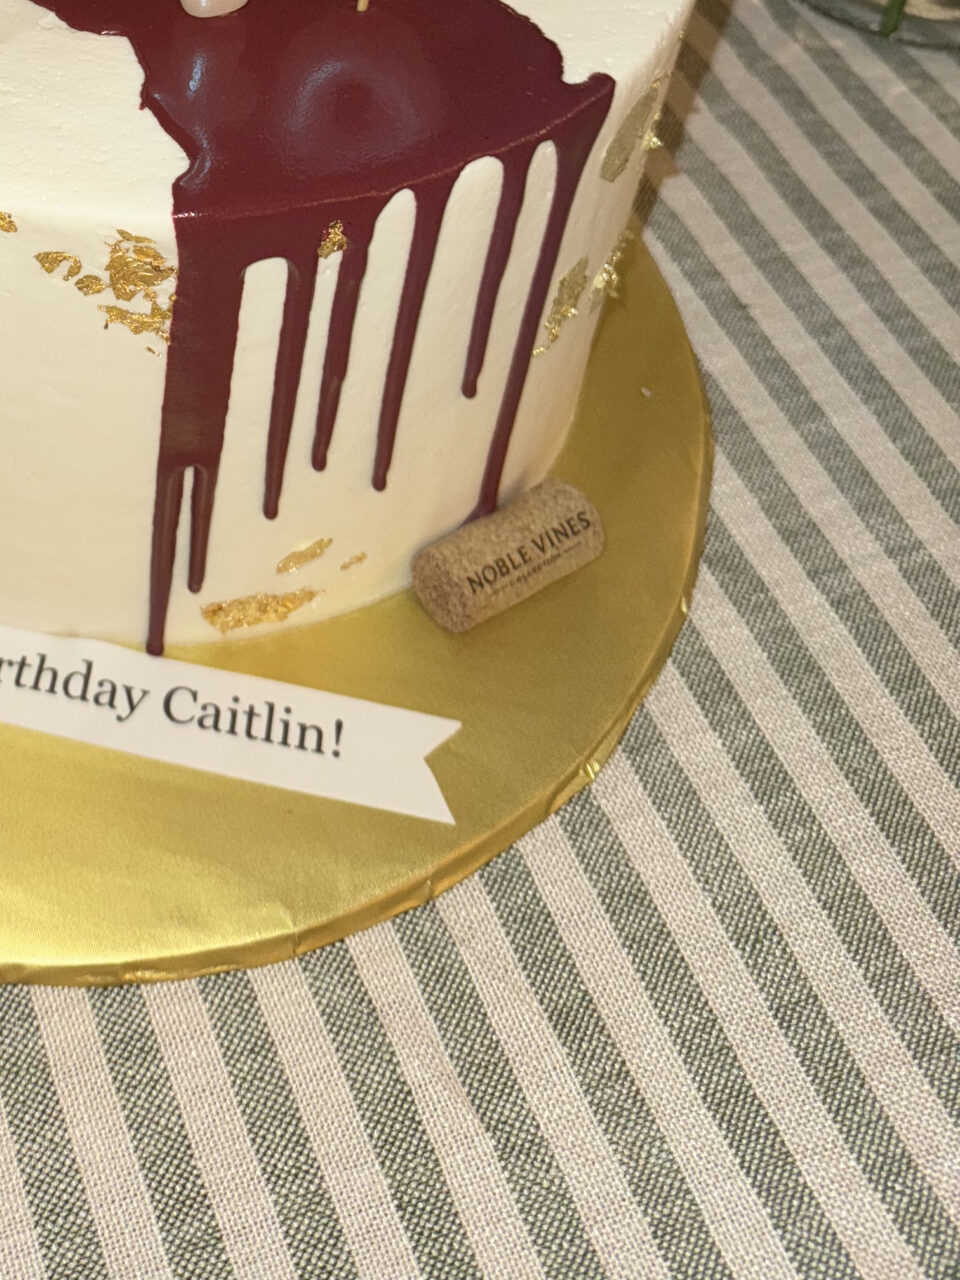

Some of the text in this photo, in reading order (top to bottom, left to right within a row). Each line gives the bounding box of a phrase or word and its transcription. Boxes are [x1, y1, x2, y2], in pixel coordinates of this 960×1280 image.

[466, 510, 591, 595] NOBLE VINES
[162, 685, 344, 758] Caitlin!
